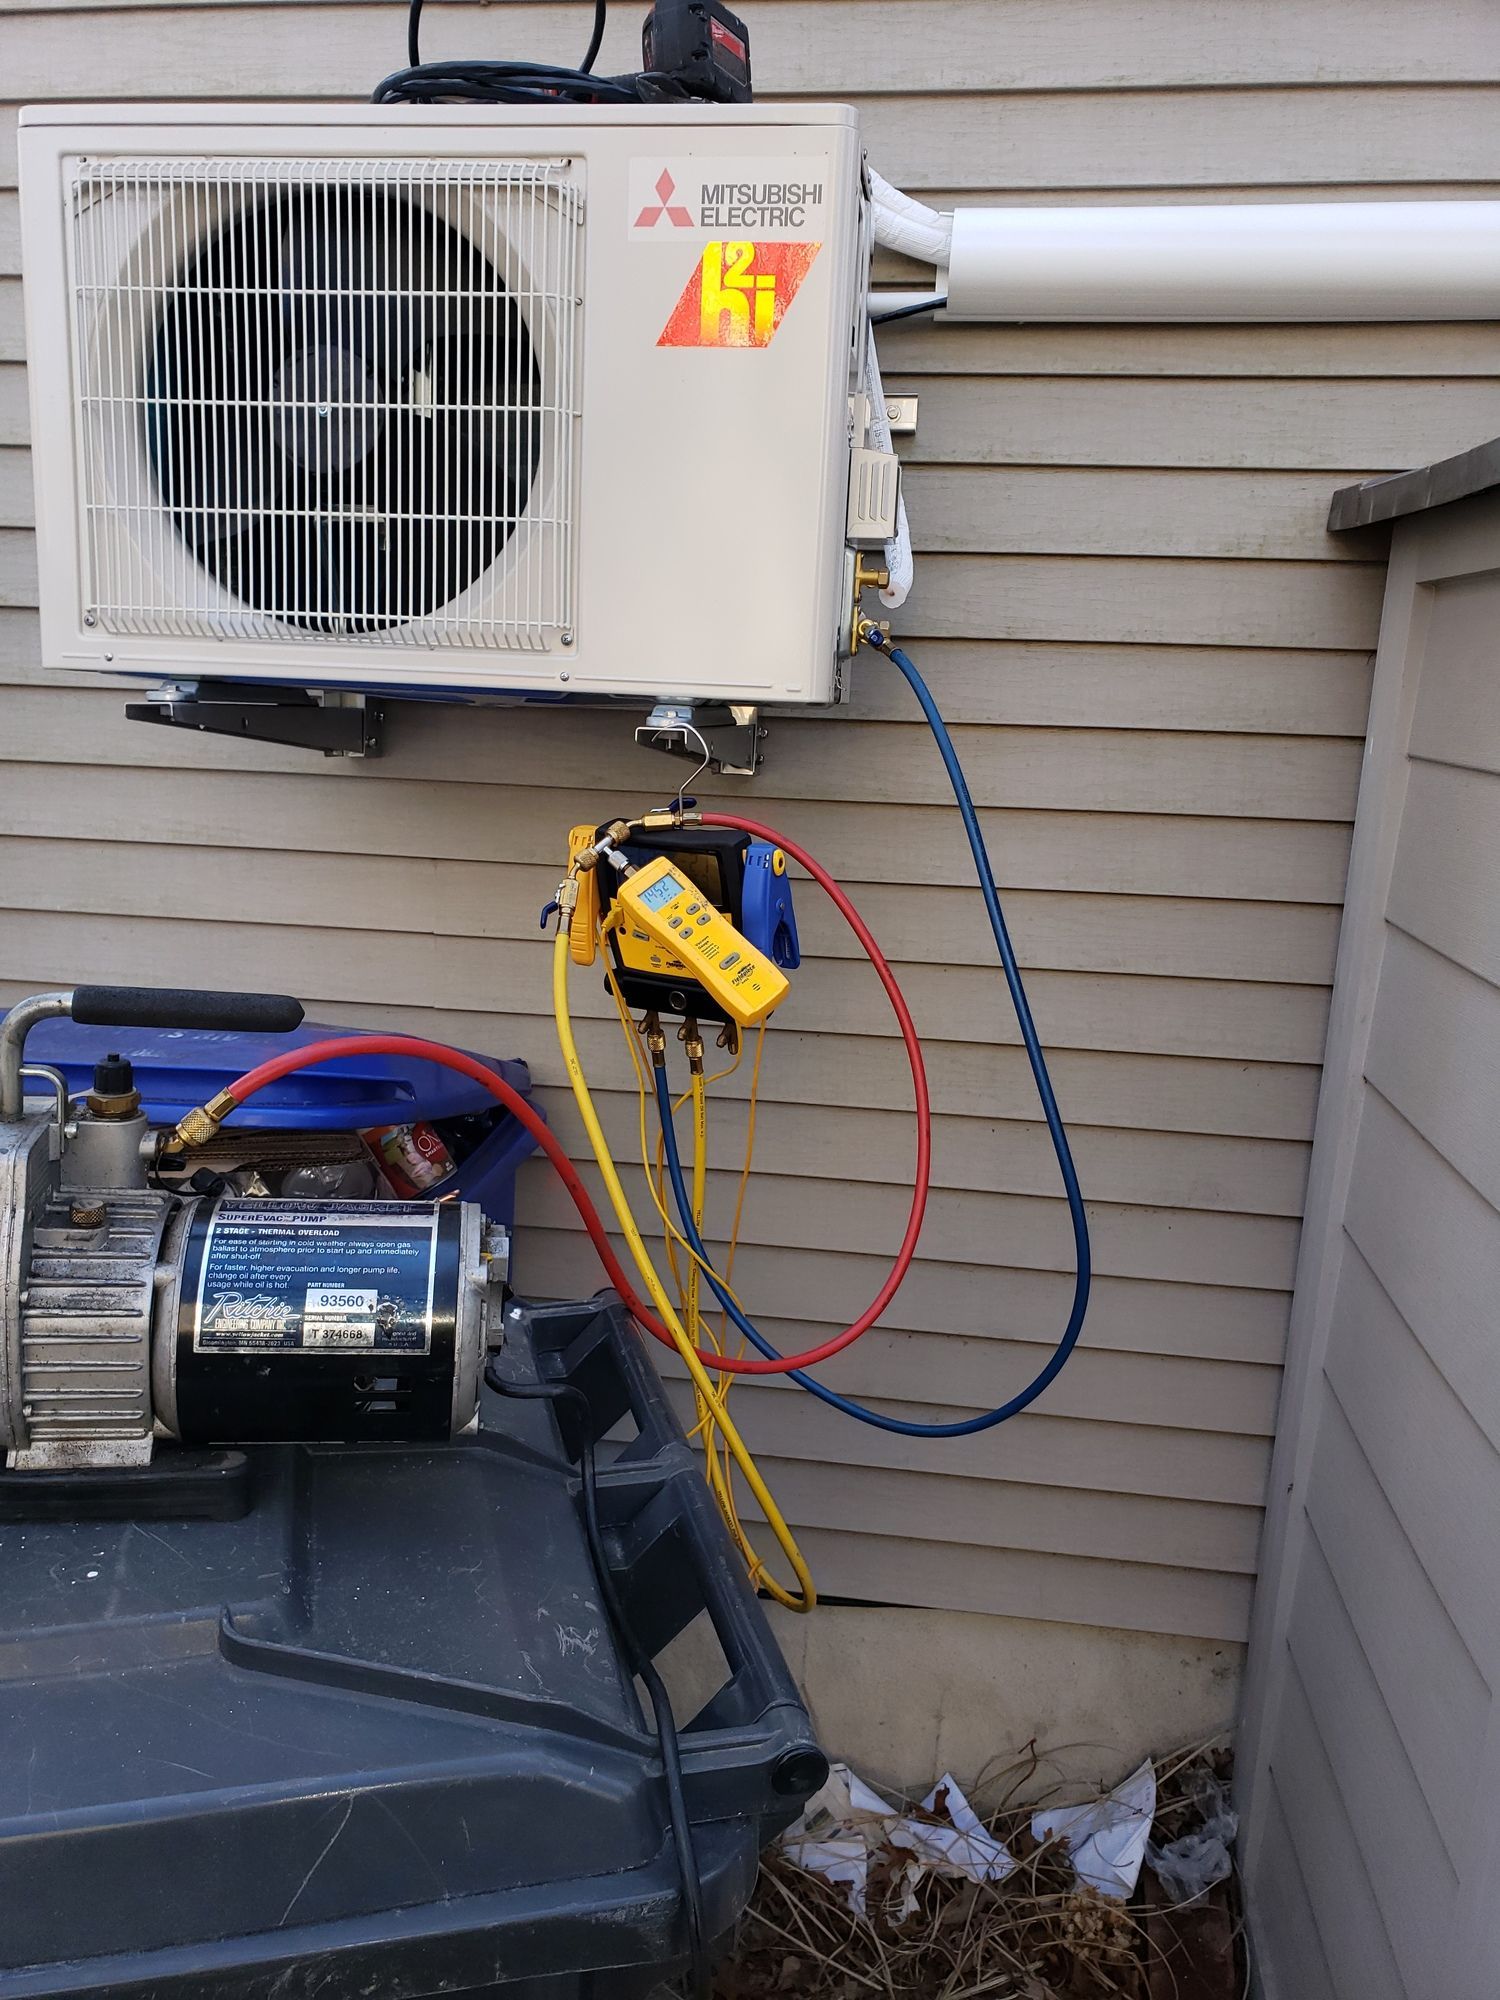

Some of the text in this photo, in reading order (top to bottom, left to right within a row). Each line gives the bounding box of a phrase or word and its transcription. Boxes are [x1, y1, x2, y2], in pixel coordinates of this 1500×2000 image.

[701, 184, 822, 204] MITSUBISHI
[700, 207, 805, 227] ELECTRIC
[250, 1264, 274, 1272] higher
[320, 1295, 364, 1307] 93560
[204, 1291, 300, 1324] Ritchie
[215, 1319, 249, 1329] ENGINEERING
[250, 1319, 276, 1329] COMPANY
[312, 1329, 363, 1339] T 374668
